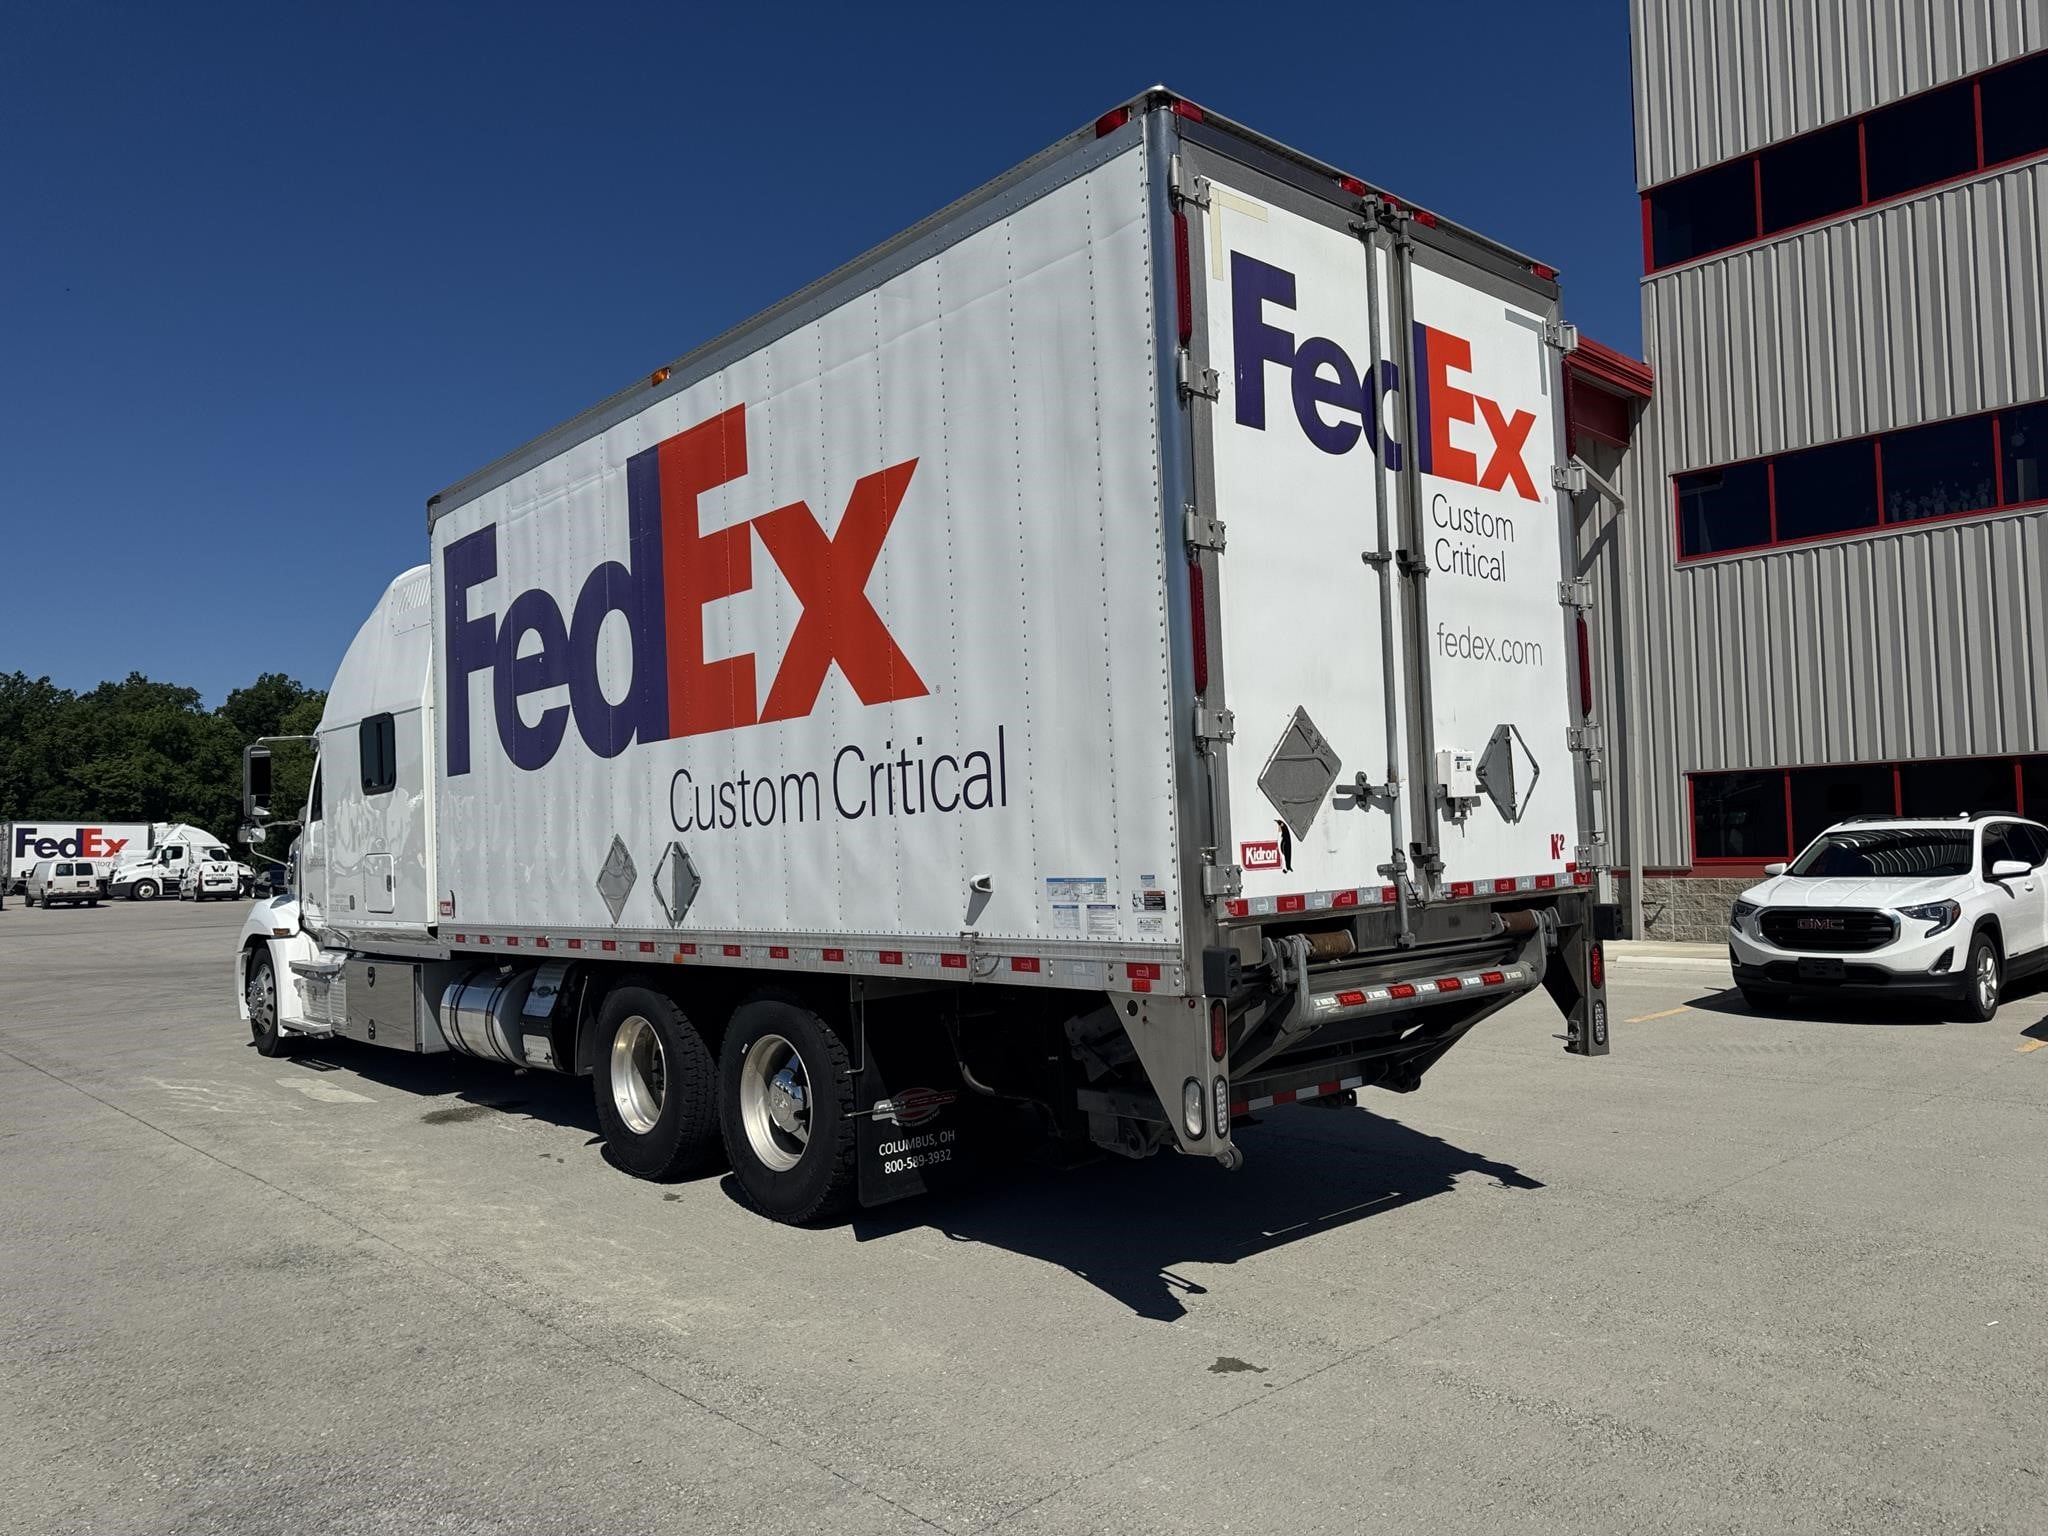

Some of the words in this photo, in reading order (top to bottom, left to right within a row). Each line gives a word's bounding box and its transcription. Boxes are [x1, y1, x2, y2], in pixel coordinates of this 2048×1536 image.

[1230, 249, 1541, 503] FedEx
[1432, 493, 1515, 543] Custom
[1434, 538, 1507, 582] Critical
[443, 402, 930, 777] FedEx
[1436, 622, 1544, 667] fedex.com
[669, 768, 820, 833] Custom
[833, 725, 1008, 820] Critical
[15, 827, 129, 858] FedEx
[1245, 846, 1278, 865] Kidron
[1797, 918, 1845, 930] GMC
[879, 1134, 938, 1156] COLUMBUS,
[940, 1130, 955, 1143] OH
[884, 1149, 952, 1174] 800-589-3932
